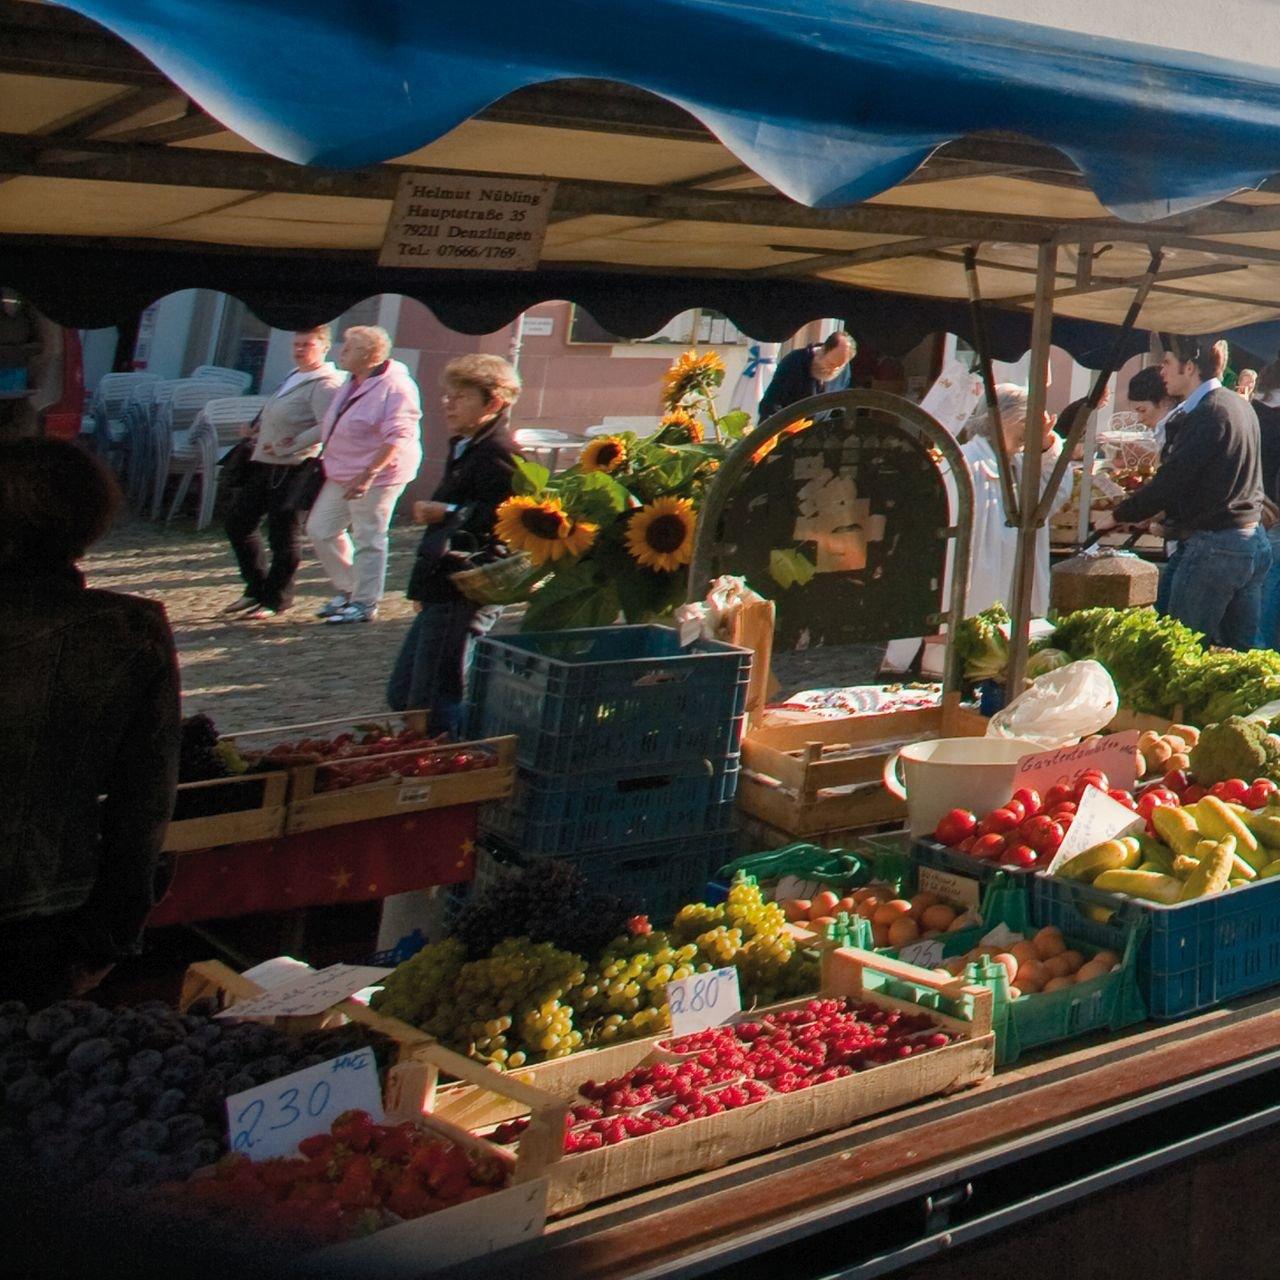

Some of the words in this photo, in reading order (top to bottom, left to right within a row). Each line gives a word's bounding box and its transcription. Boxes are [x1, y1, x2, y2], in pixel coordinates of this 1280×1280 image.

[411, 185, 471, 200] Helmut
[478, 188, 541, 206] Nübling
[407, 204, 504, 222] Hauptstraße
[509, 210, 527, 222] 35
[403, 223, 440, 238] 79211
[447, 225, 533, 242] Denzlingen
[233, 1080, 330, 1151] 2.30
